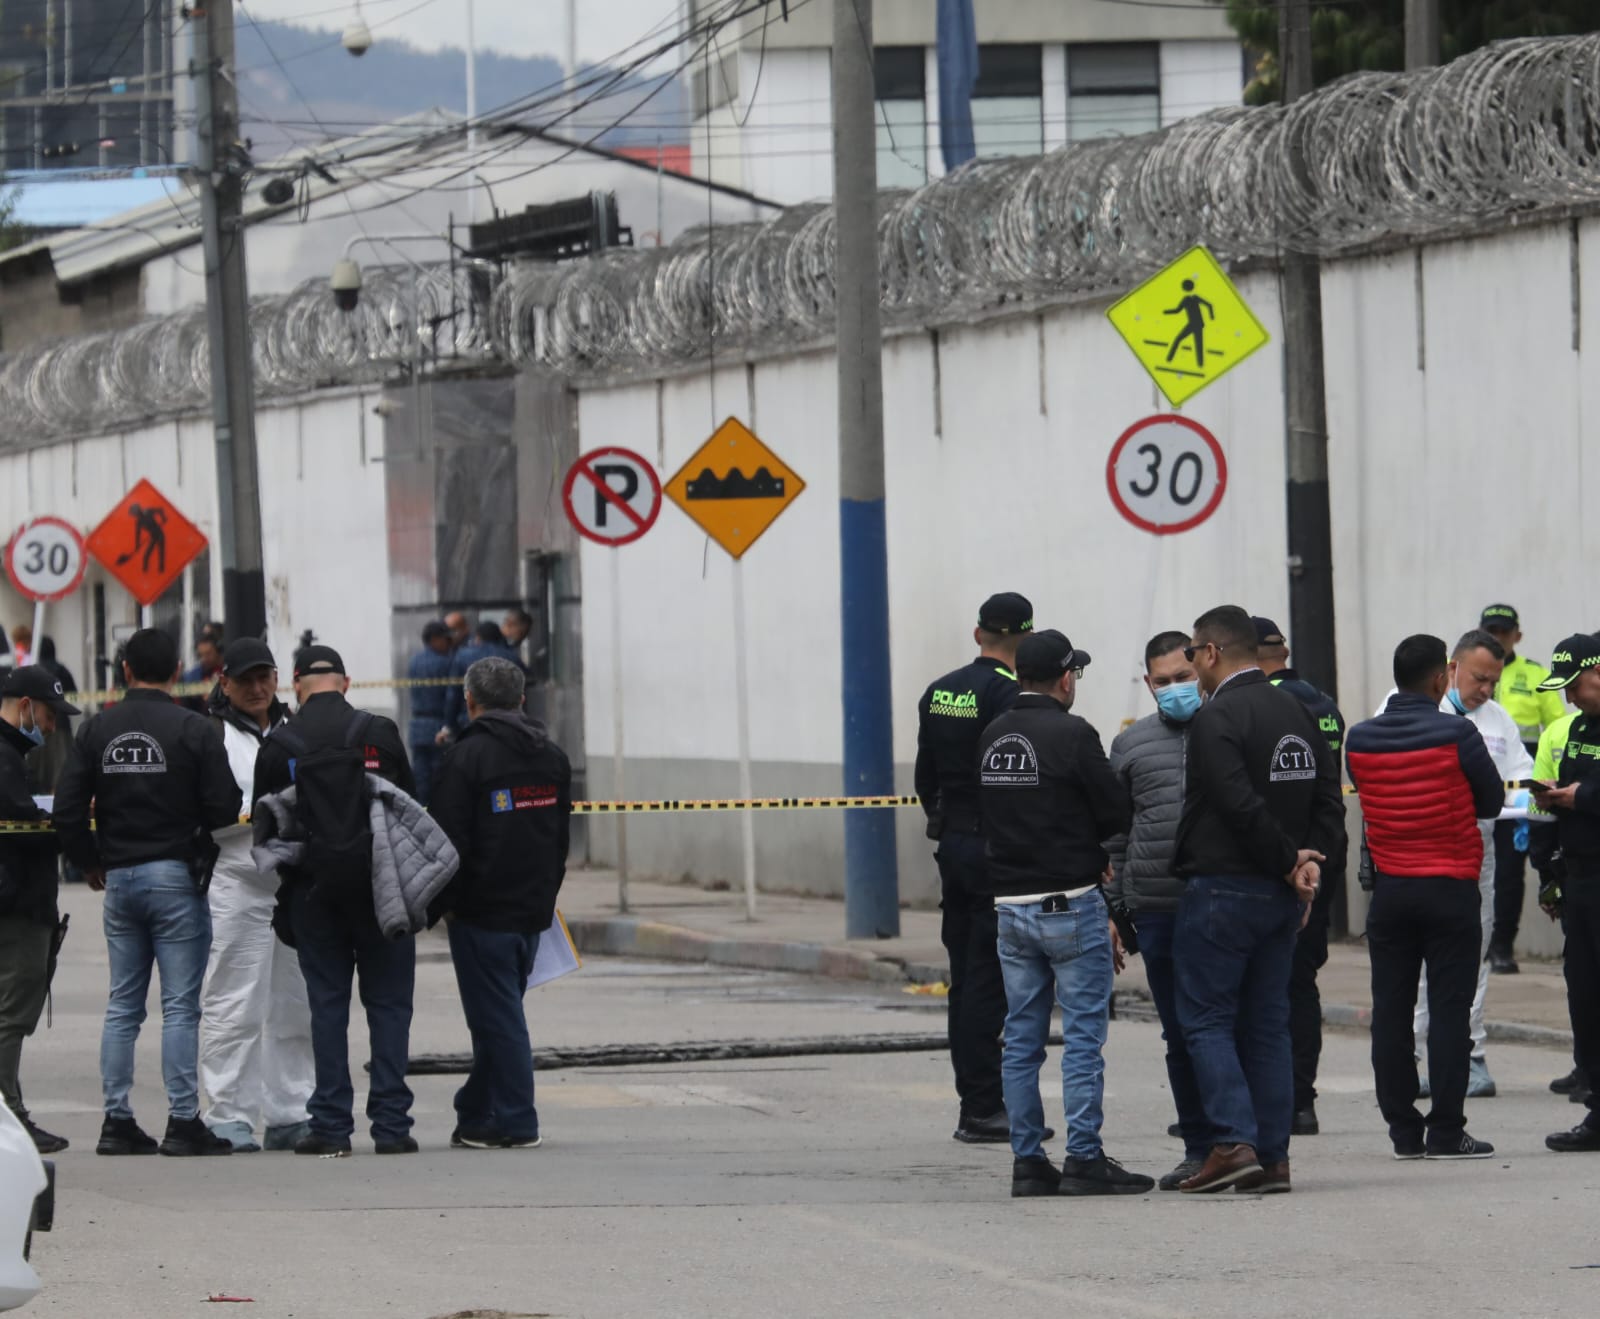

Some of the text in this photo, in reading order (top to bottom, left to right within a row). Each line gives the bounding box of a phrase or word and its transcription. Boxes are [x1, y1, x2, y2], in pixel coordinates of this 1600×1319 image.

[1129, 443, 1203, 506] 30
[595, 464, 638, 528] P
[24, 541, 69, 576] 30
[111, 747, 153, 763] CTI
[990, 753, 1027, 770] CTI
[1279, 751, 1310, 769] CTI
